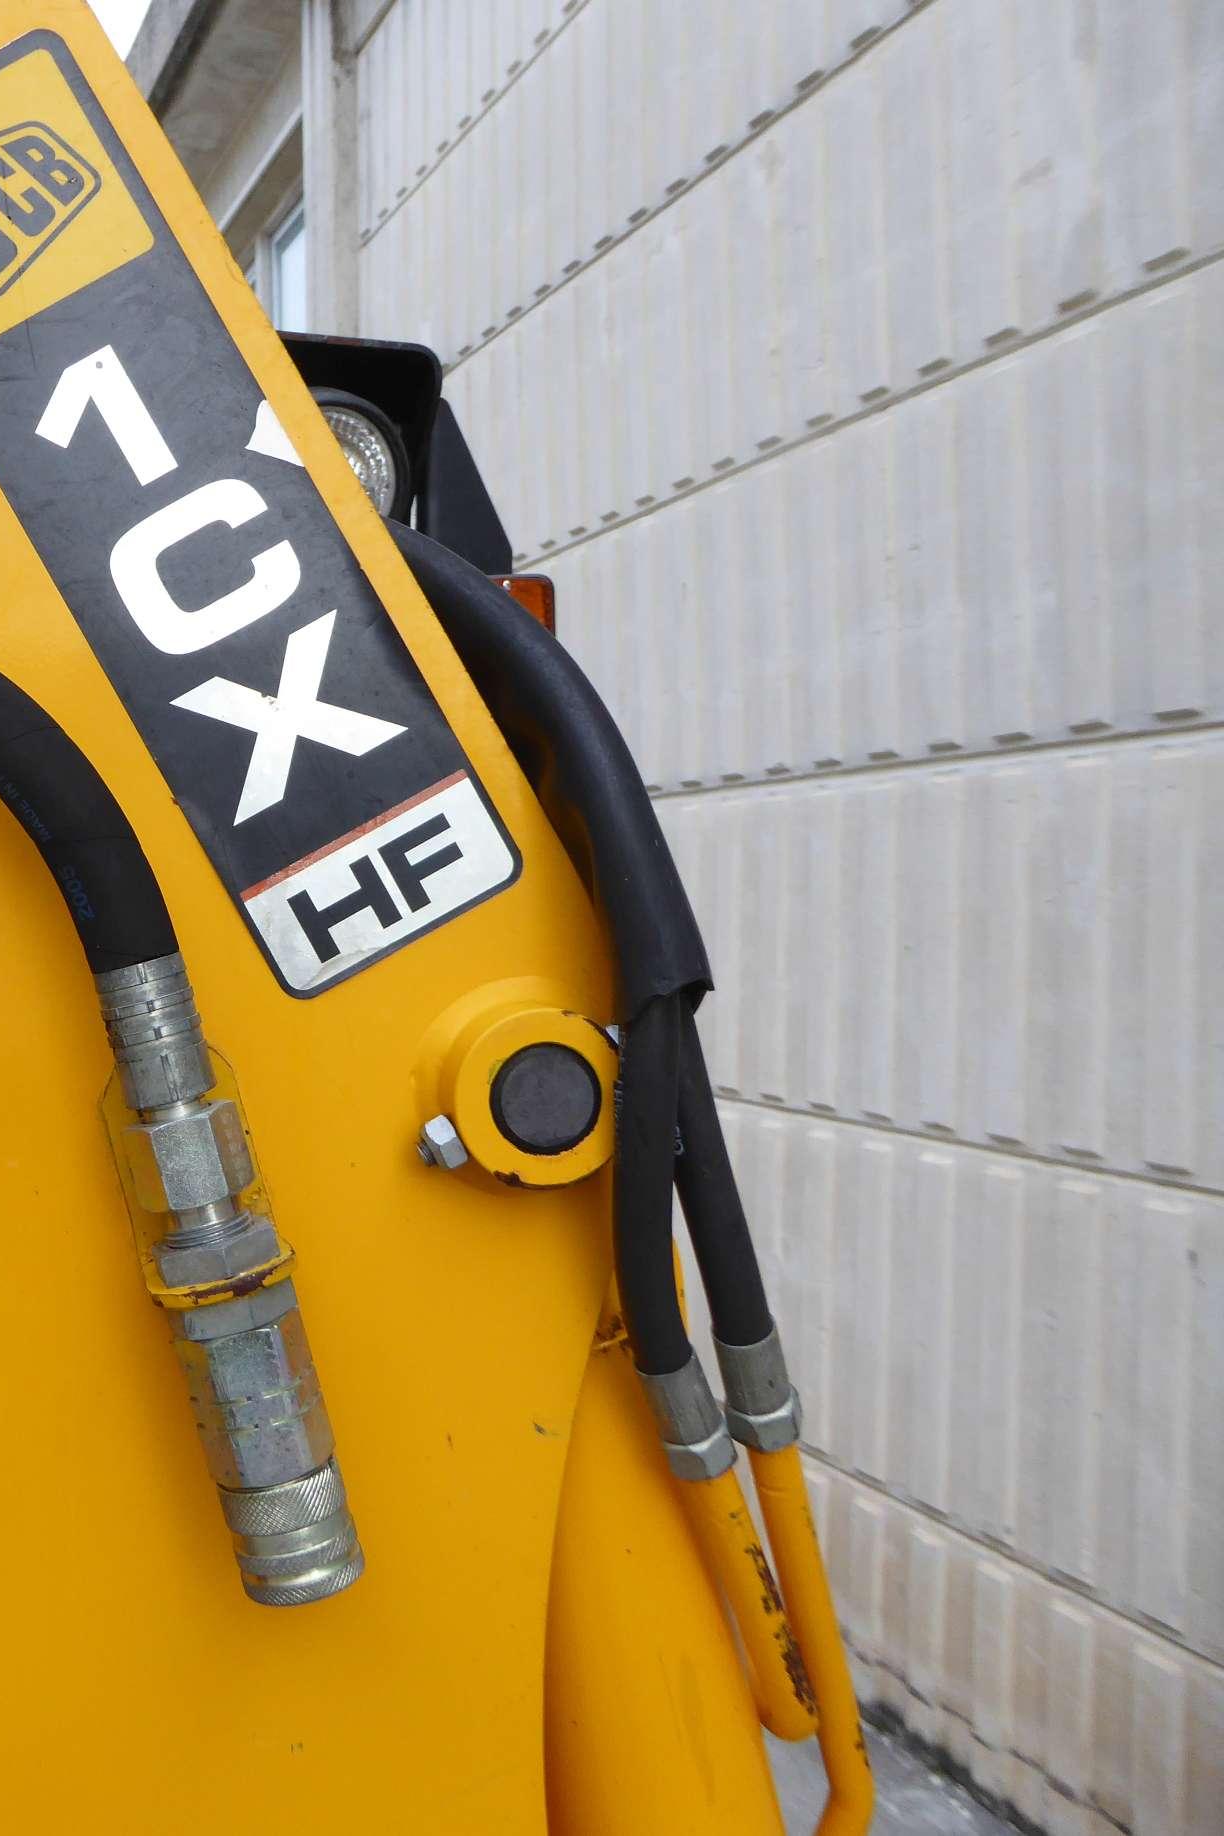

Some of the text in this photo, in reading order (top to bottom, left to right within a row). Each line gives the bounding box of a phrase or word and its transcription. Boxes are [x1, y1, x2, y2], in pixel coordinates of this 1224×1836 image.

[35, 344, 408, 827] 1CX
[20, 799, 53, 842] MADE
[288, 812, 472, 963] HF
